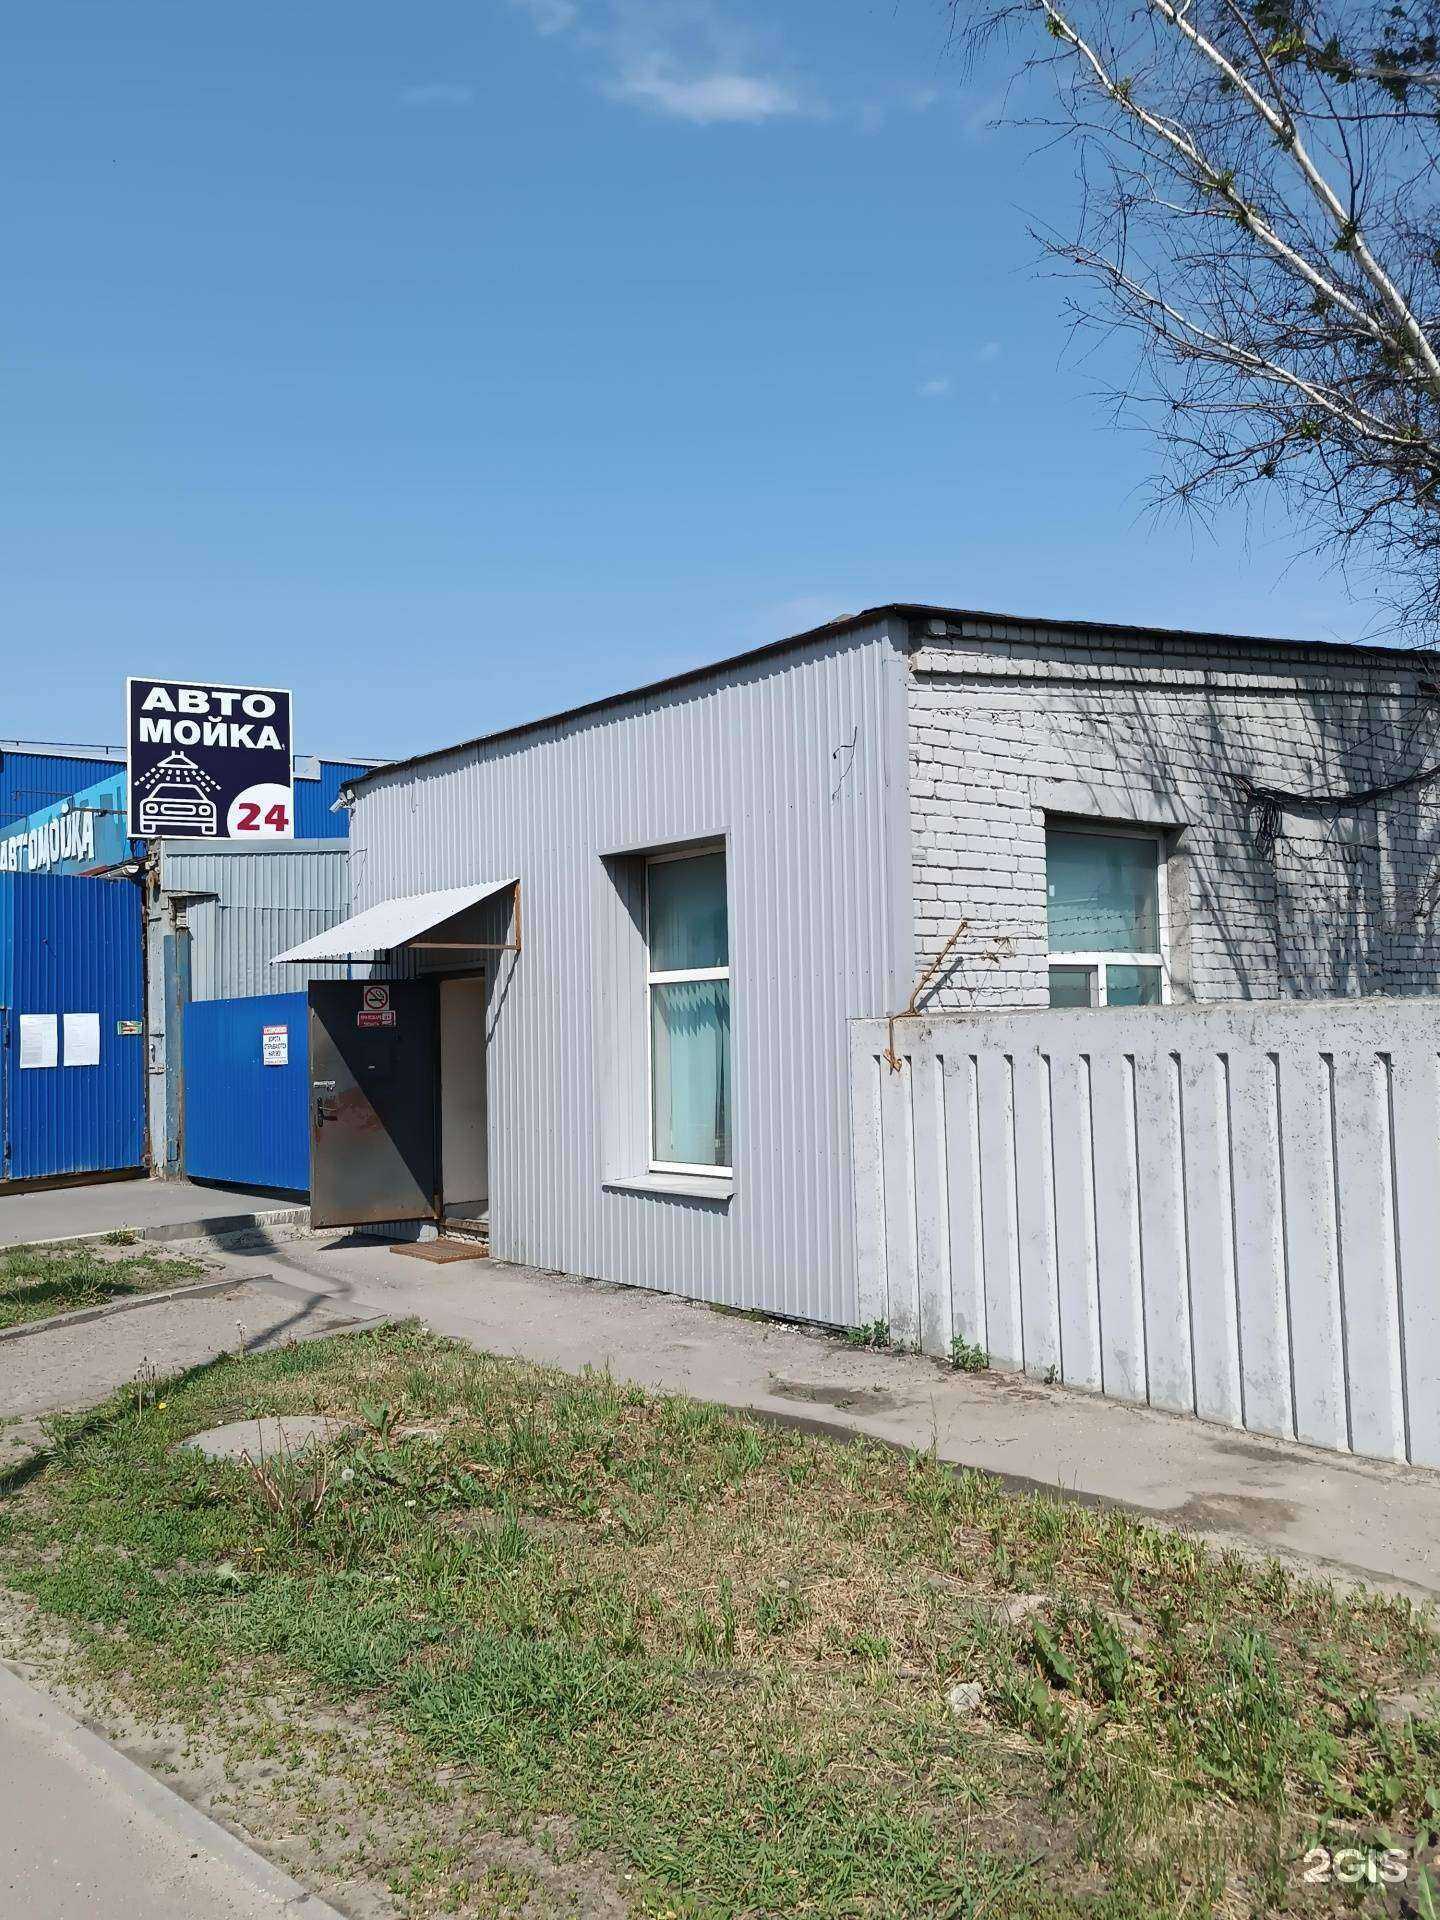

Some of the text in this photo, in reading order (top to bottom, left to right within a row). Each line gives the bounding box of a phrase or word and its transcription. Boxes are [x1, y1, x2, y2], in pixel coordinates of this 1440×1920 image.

[141, 686, 276, 719] АВТО
[139, 716, 282, 750] МОЙКА
[237, 802, 289, 832] 24
